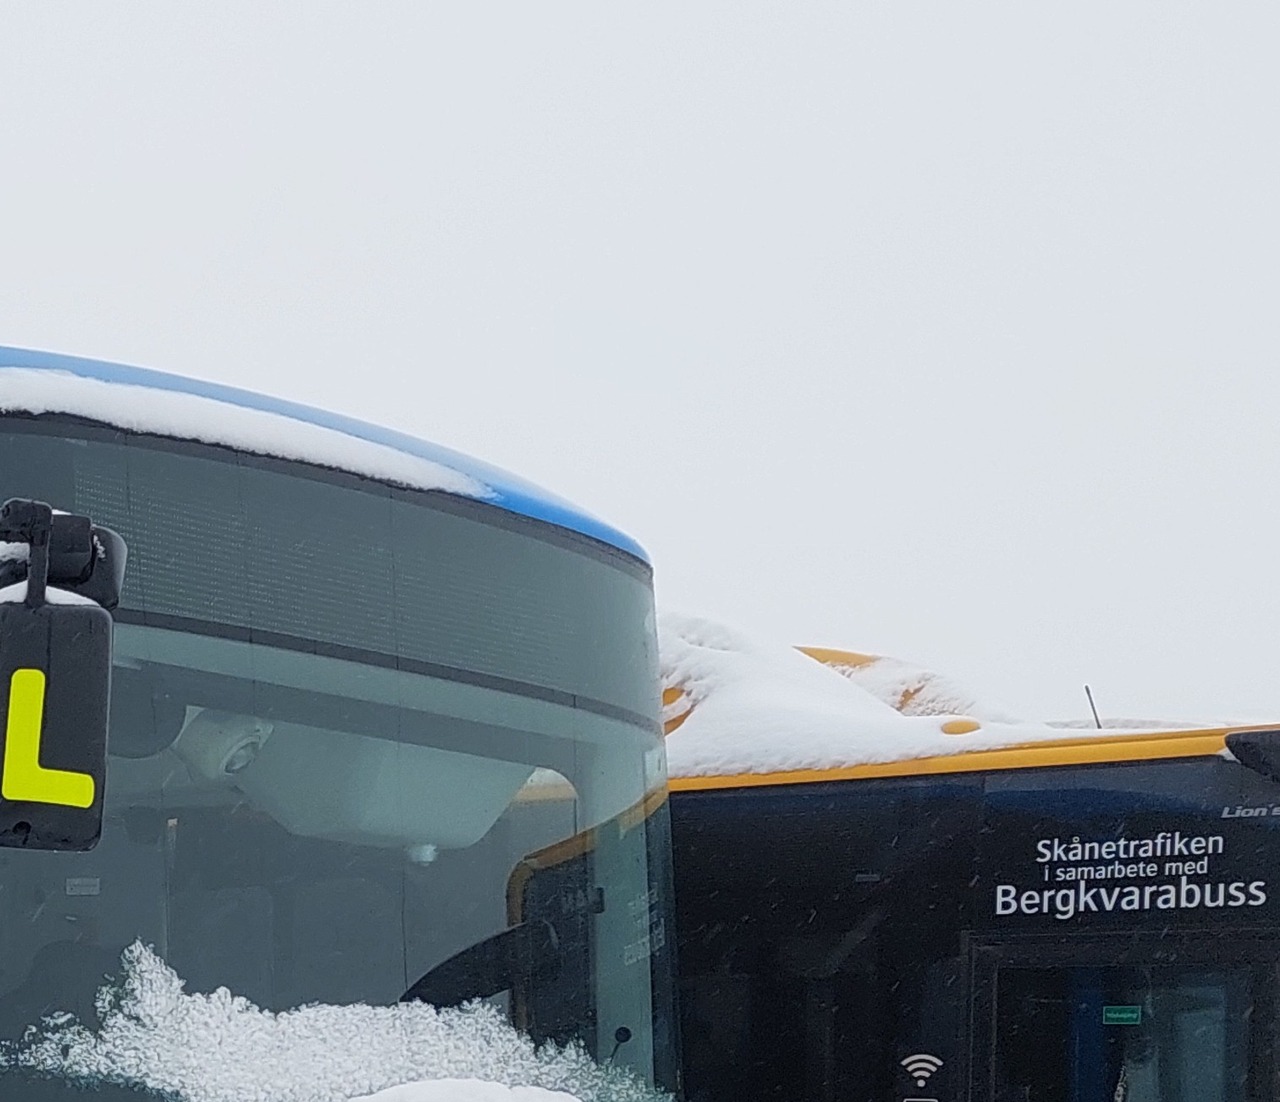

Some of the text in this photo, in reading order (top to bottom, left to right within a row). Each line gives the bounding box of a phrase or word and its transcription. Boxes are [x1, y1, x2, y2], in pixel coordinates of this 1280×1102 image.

[1036, 831, 1224, 863] Skånetrafiken
[1044, 856, 1209, 881] i samarbete med
[995, 876, 1267, 919] Bergkvarabuss
